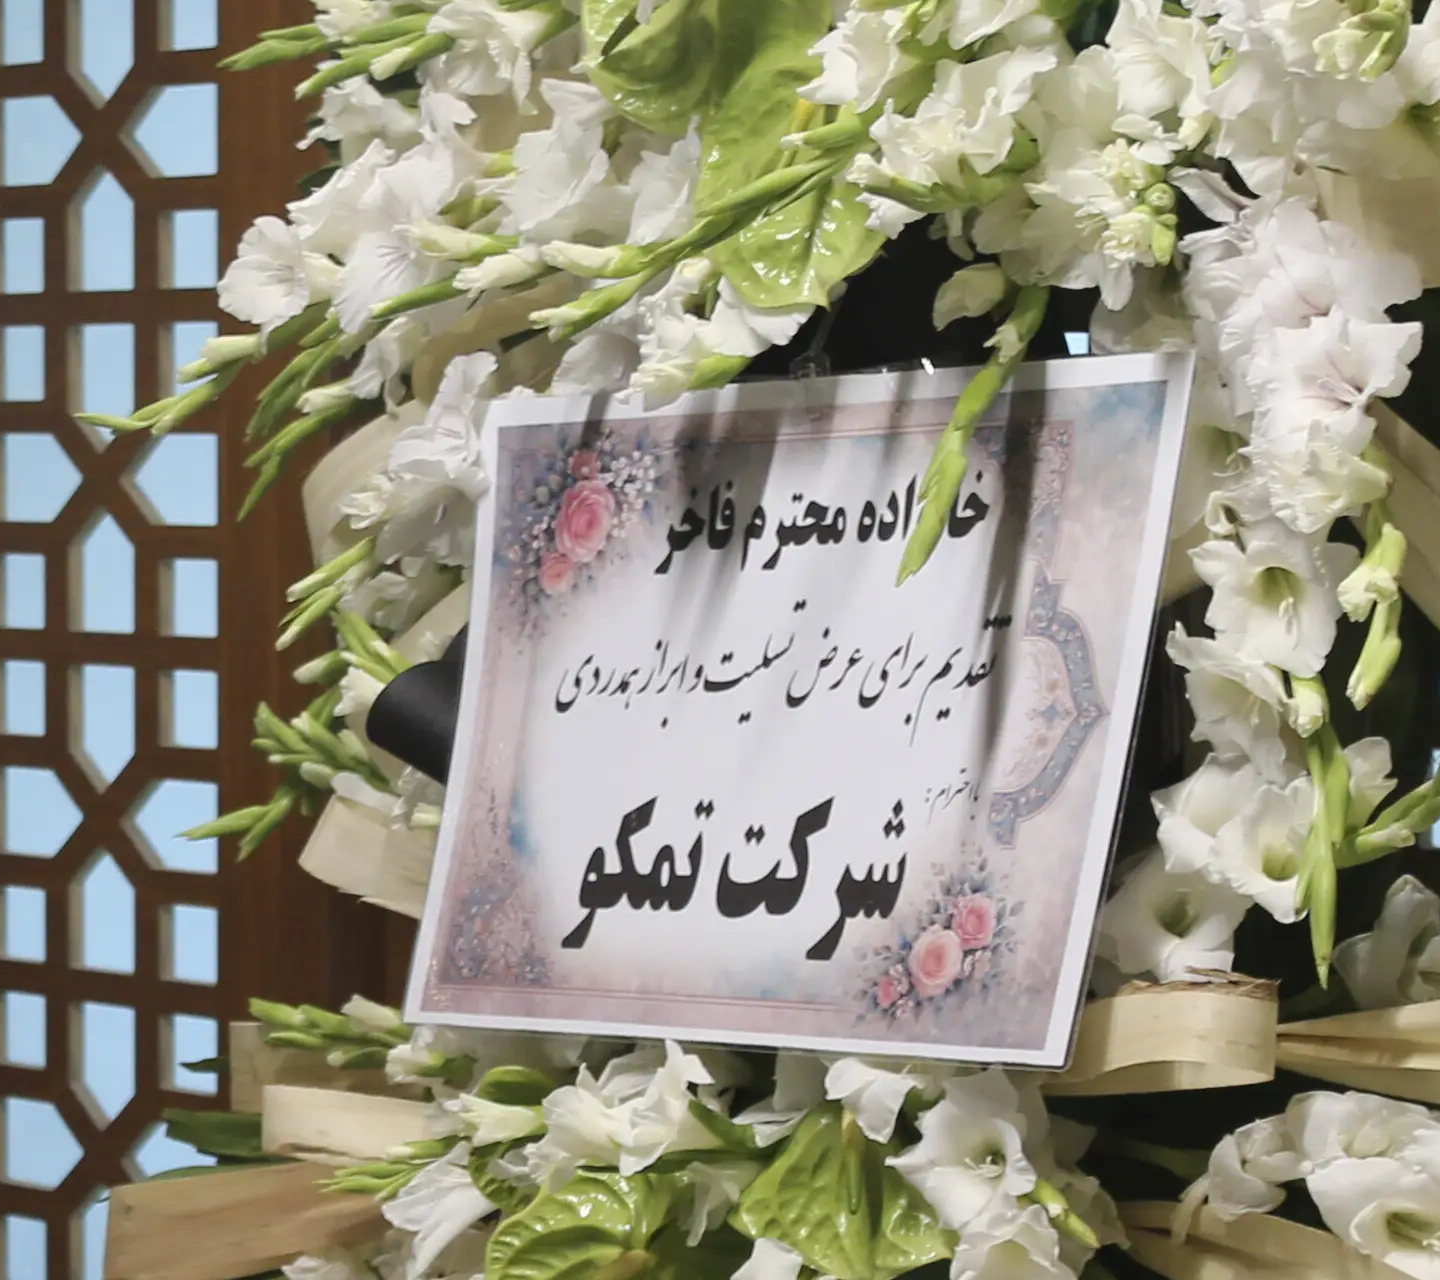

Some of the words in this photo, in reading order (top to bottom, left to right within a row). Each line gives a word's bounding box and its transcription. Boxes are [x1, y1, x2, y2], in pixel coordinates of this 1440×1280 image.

[654, 480, 736, 575] فاخر
[741, 493, 846, 571] محترم
[857, 470, 991, 543] خااده
[555, 653, 637, 713] همدردی
[636, 640, 690, 729] ابراز
[686, 664, 704, 694] و
[703, 599, 807, 725] تسلیت
[786, 627, 862, 709] عرض
[858, 632, 927, 726] برای
[909, 615, 1012, 748] تقدیم
[560, 796, 715, 949] تمکو
[716, 796, 908, 960] شرکت
